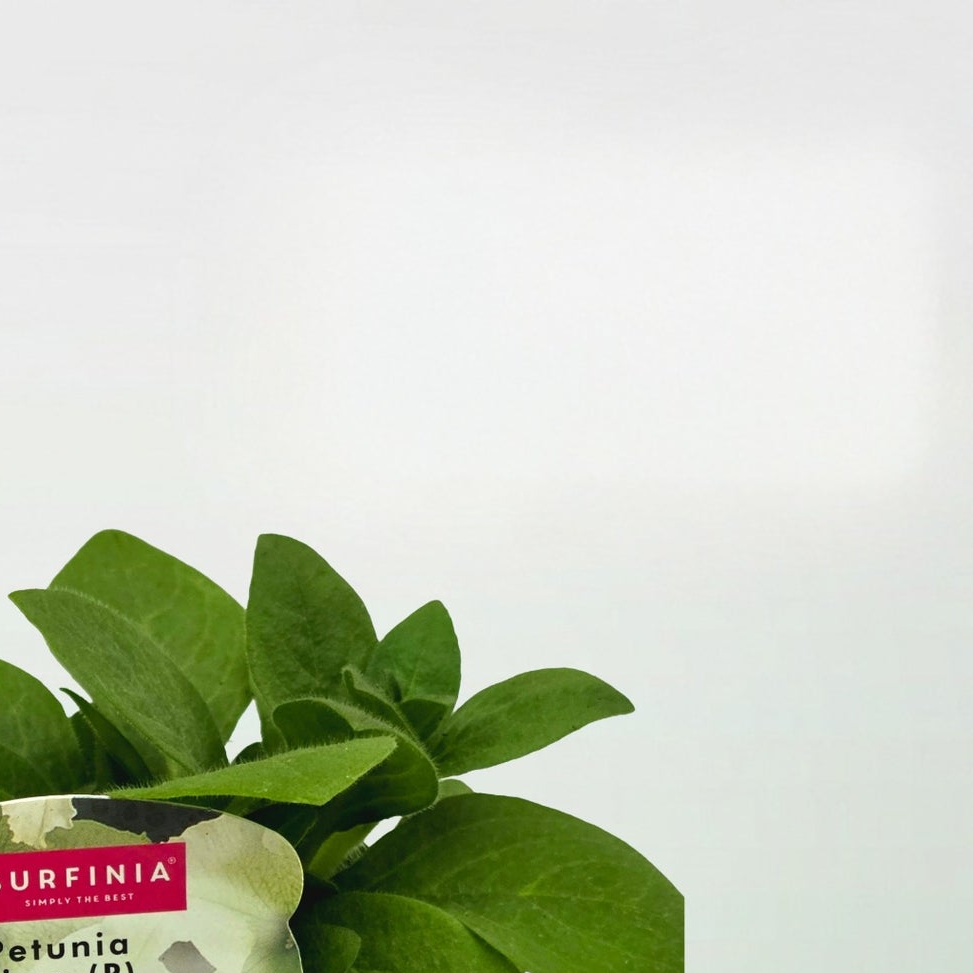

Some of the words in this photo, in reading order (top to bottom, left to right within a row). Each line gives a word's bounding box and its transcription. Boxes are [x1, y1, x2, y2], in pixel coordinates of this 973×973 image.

[25, 897, 71, 907] SIMPLY
[76, 895, 100, 904] THE
[104, 892, 135, 902] BEST
